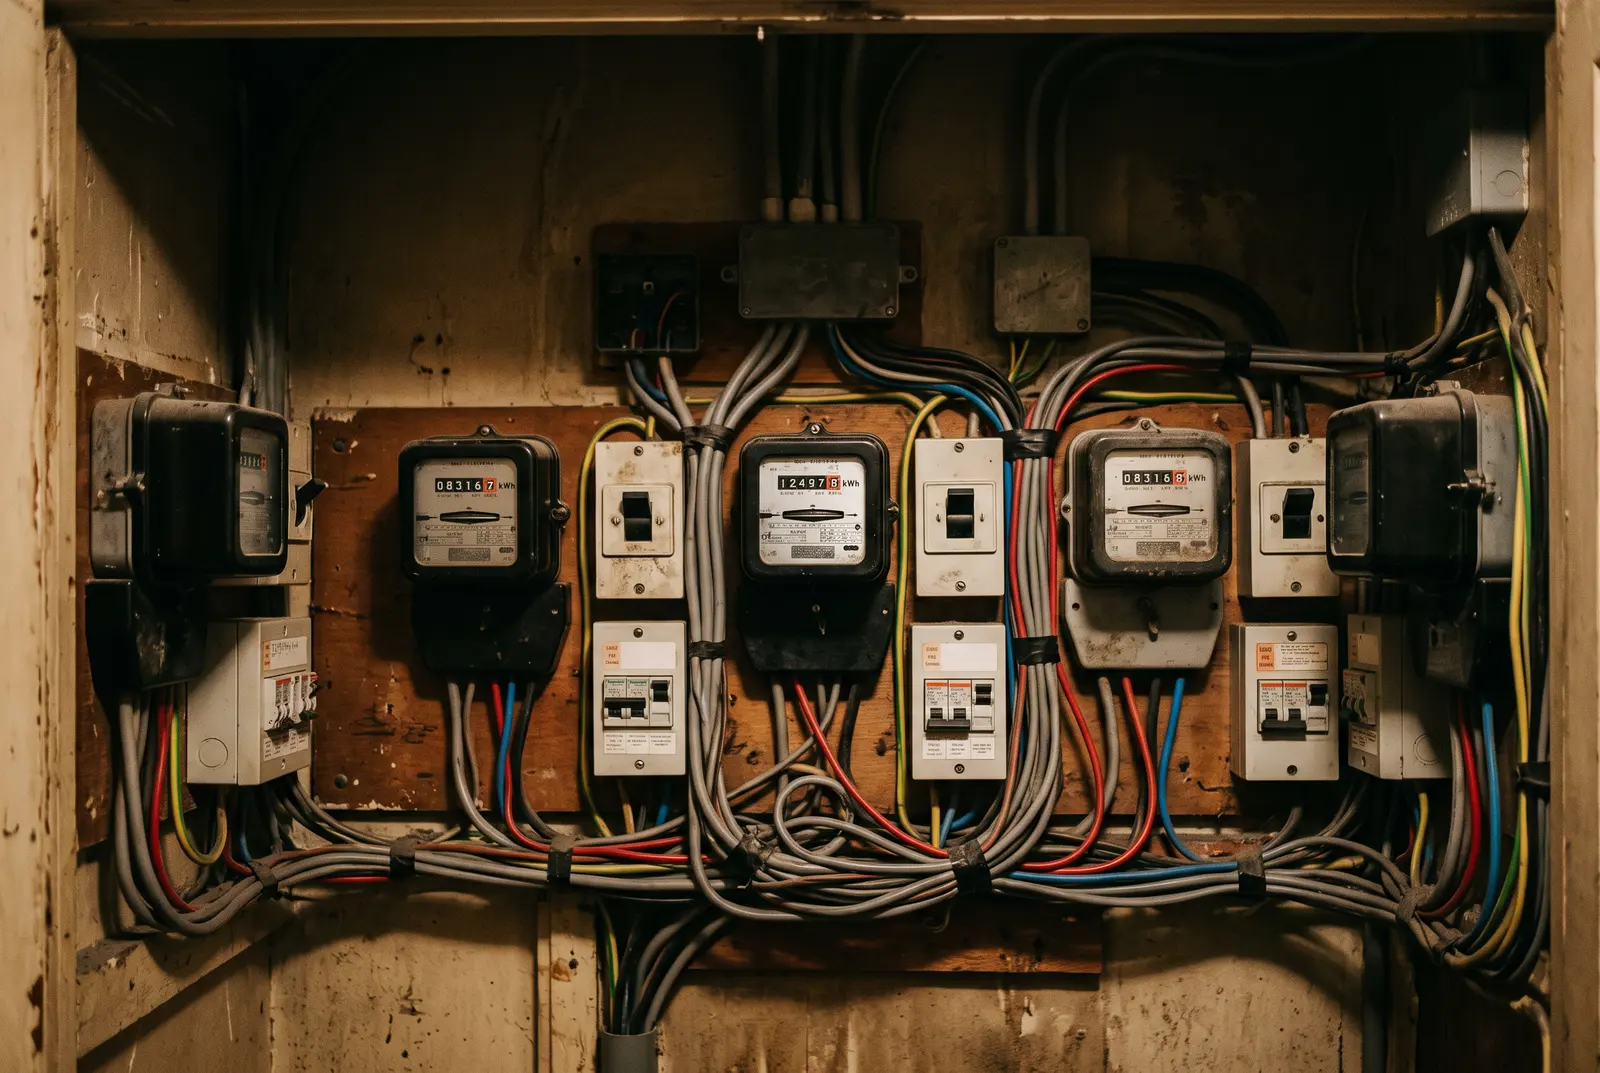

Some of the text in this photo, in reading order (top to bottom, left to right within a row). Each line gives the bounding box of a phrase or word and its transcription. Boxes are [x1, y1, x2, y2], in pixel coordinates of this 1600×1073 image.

[1188, 474, 1206, 482] kWh
[437, 481, 516, 490] 083167 kWh
[842, 480, 860, 488] kWh
